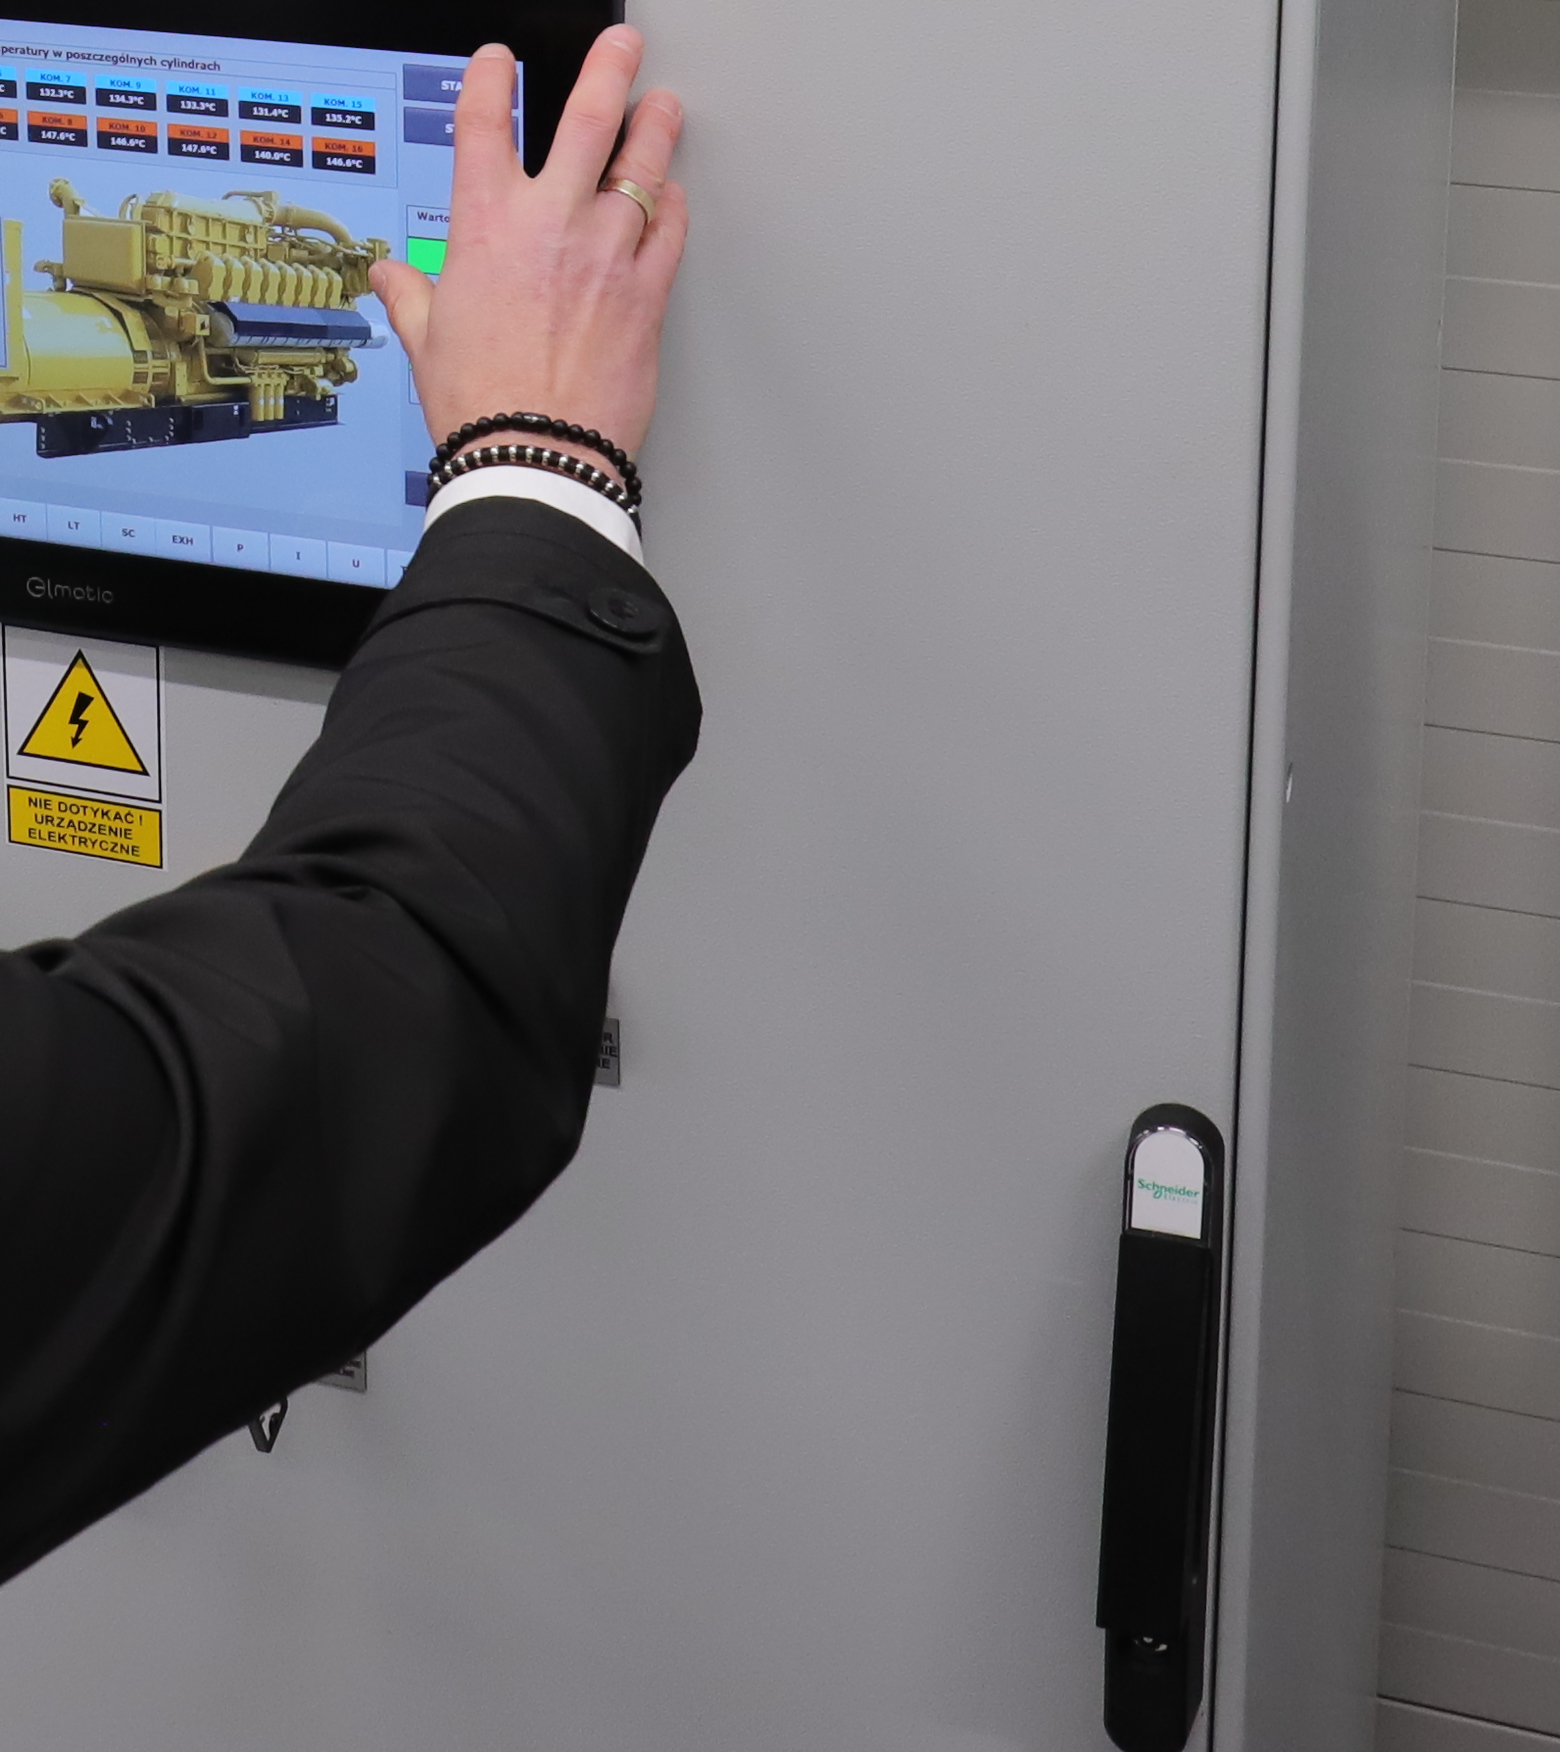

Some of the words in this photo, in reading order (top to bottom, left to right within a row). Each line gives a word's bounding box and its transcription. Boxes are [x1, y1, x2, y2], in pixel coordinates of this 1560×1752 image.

[52, 49, 63, 58] w
[66, 49, 157, 68] poszczególnych
[160, 56, 221, 72] cylindrach
[40, 73, 63, 83] KOM.
[110, 79, 134, 89] KOM.
[441, 80, 463, 91] STA
[178, 85, 202, 95] KOM.
[251, 91, 275, 102] KOM.
[324, 98, 348, 108] KOM.
[42, 115, 65, 126] KOM.
[108, 122, 133, 132] KOM.
[324, 142, 349, 152] KOM.
[417, 211, 450, 223] Warto
[13, 513, 27, 524] HT
[67, 520, 80, 531] LT
[122, 528, 135, 538] SC
[172, 534, 194, 546] EXH
[237, 543, 244, 553] P
[352, 558, 360, 569] U
[28, 796, 53, 811] NIE
[58, 801, 134, 824] DOTYKAĆ
[139, 815, 143, 825] !
[34, 813, 133, 840] URZĄDZENIE
[28, 828, 140, 857] ELEKTRYCZNE
[1138, 1178, 1199, 1199] Schneider
